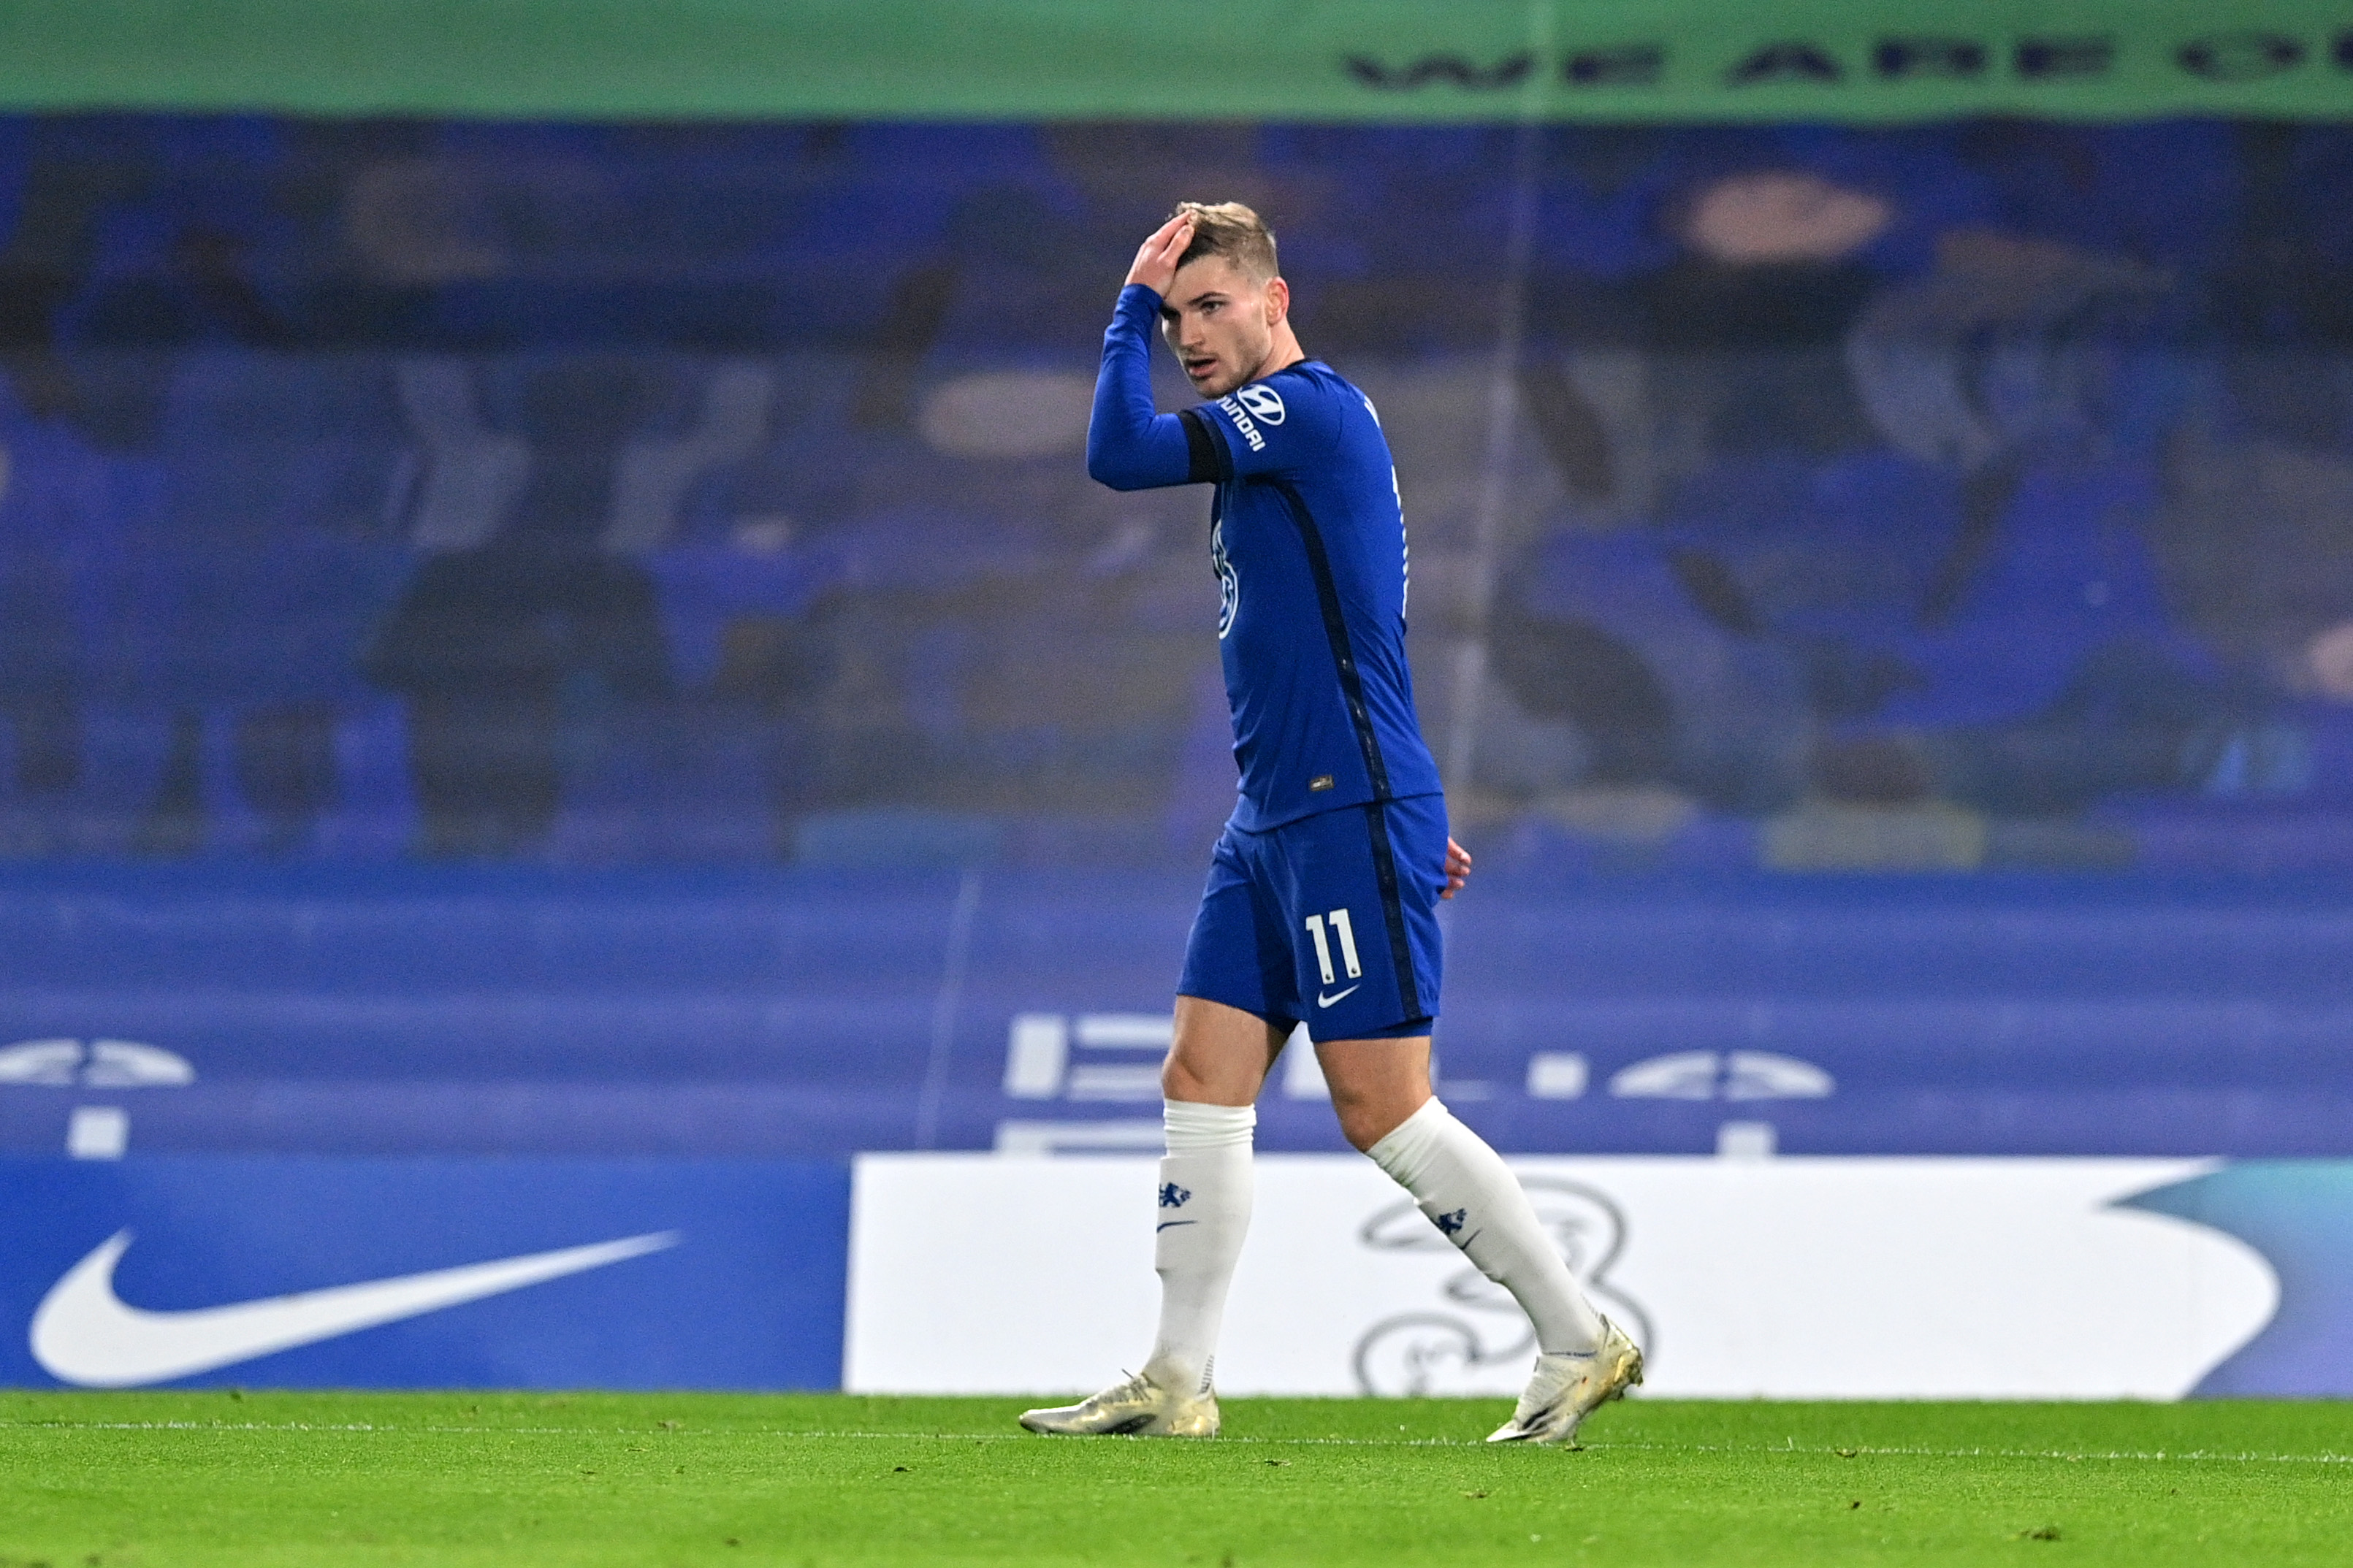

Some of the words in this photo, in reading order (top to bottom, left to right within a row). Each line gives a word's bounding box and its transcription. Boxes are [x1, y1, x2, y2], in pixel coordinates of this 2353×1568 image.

[1341, 42, 1666, 91] WE
[1725, 32, 2116, 88] ARE
[1216, 395, 1266, 452] UNDAI
[1305, 908, 1362, 984] 11
